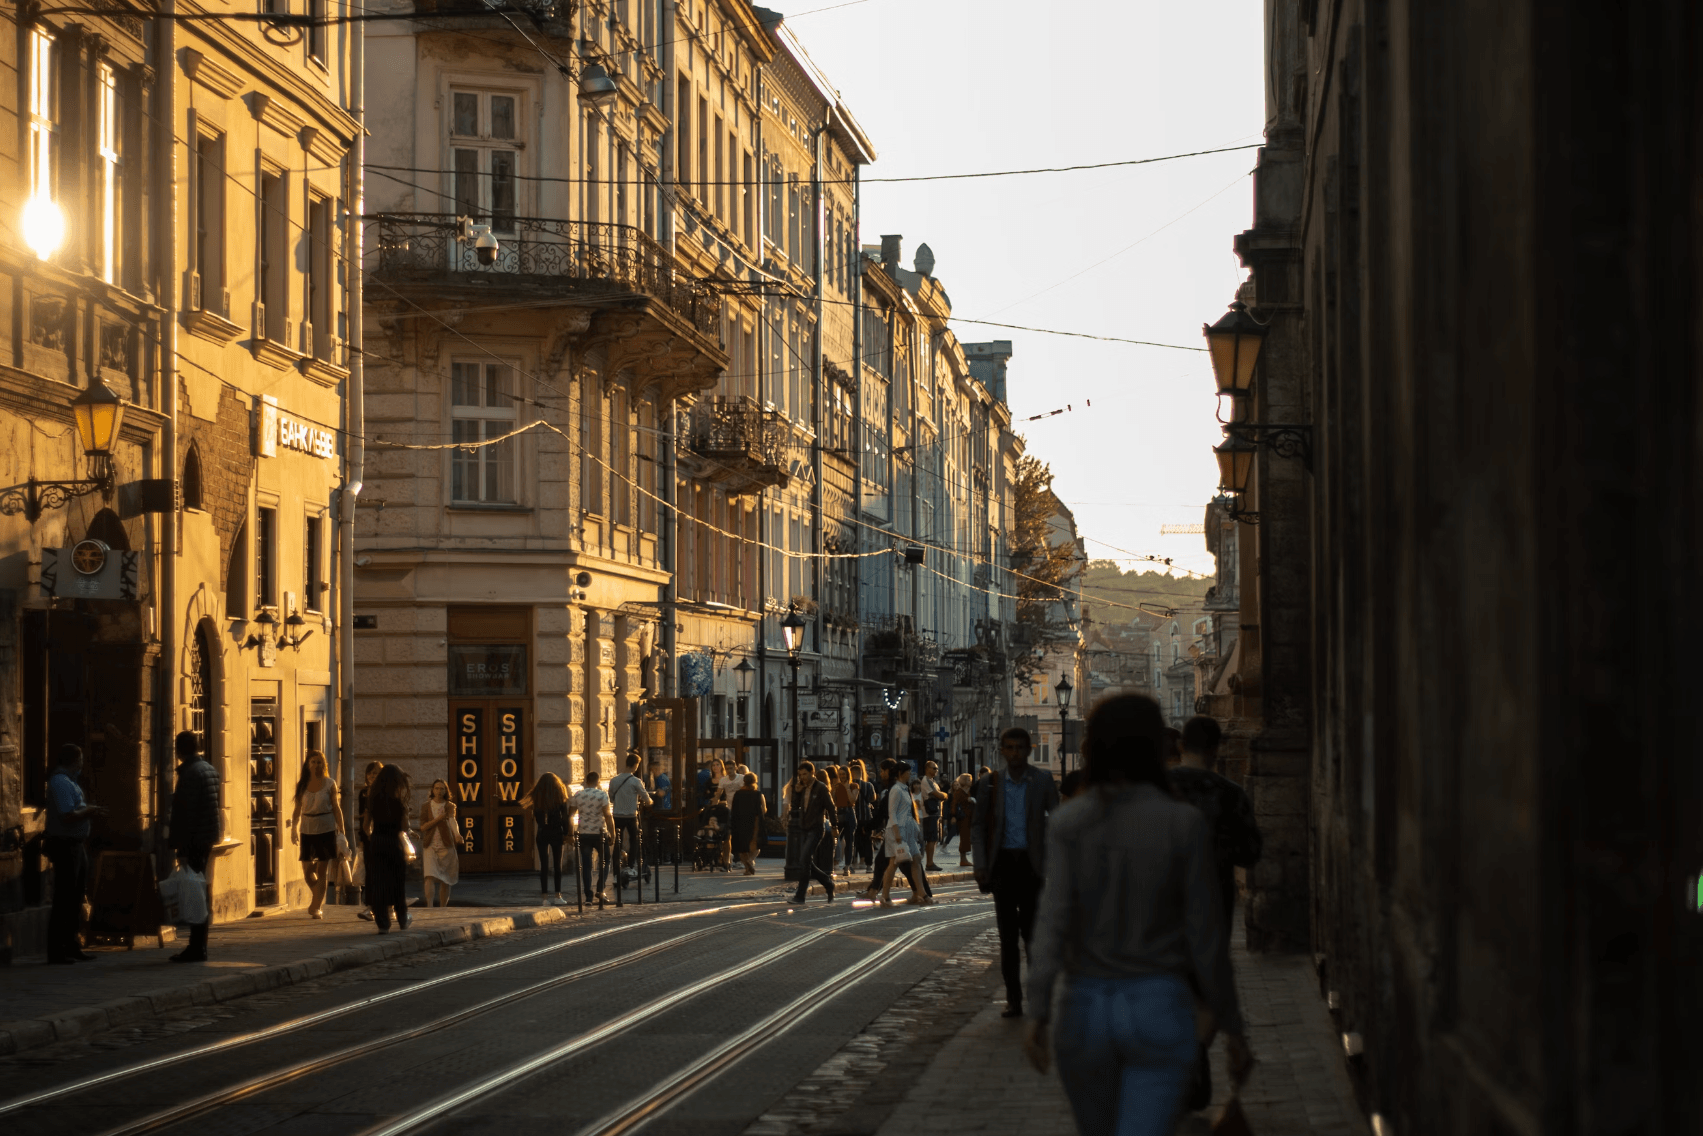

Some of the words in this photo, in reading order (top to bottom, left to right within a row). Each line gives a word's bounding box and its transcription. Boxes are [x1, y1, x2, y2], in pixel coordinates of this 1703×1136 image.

[281, 417, 308, 451] БАНК
[466, 663, 510, 673] EROS
[458, 713, 480, 802] SHOW
[498, 713, 520, 802] SHOW
[465, 817, 474, 852] BAR
[505, 816, 514, 851] BAR
